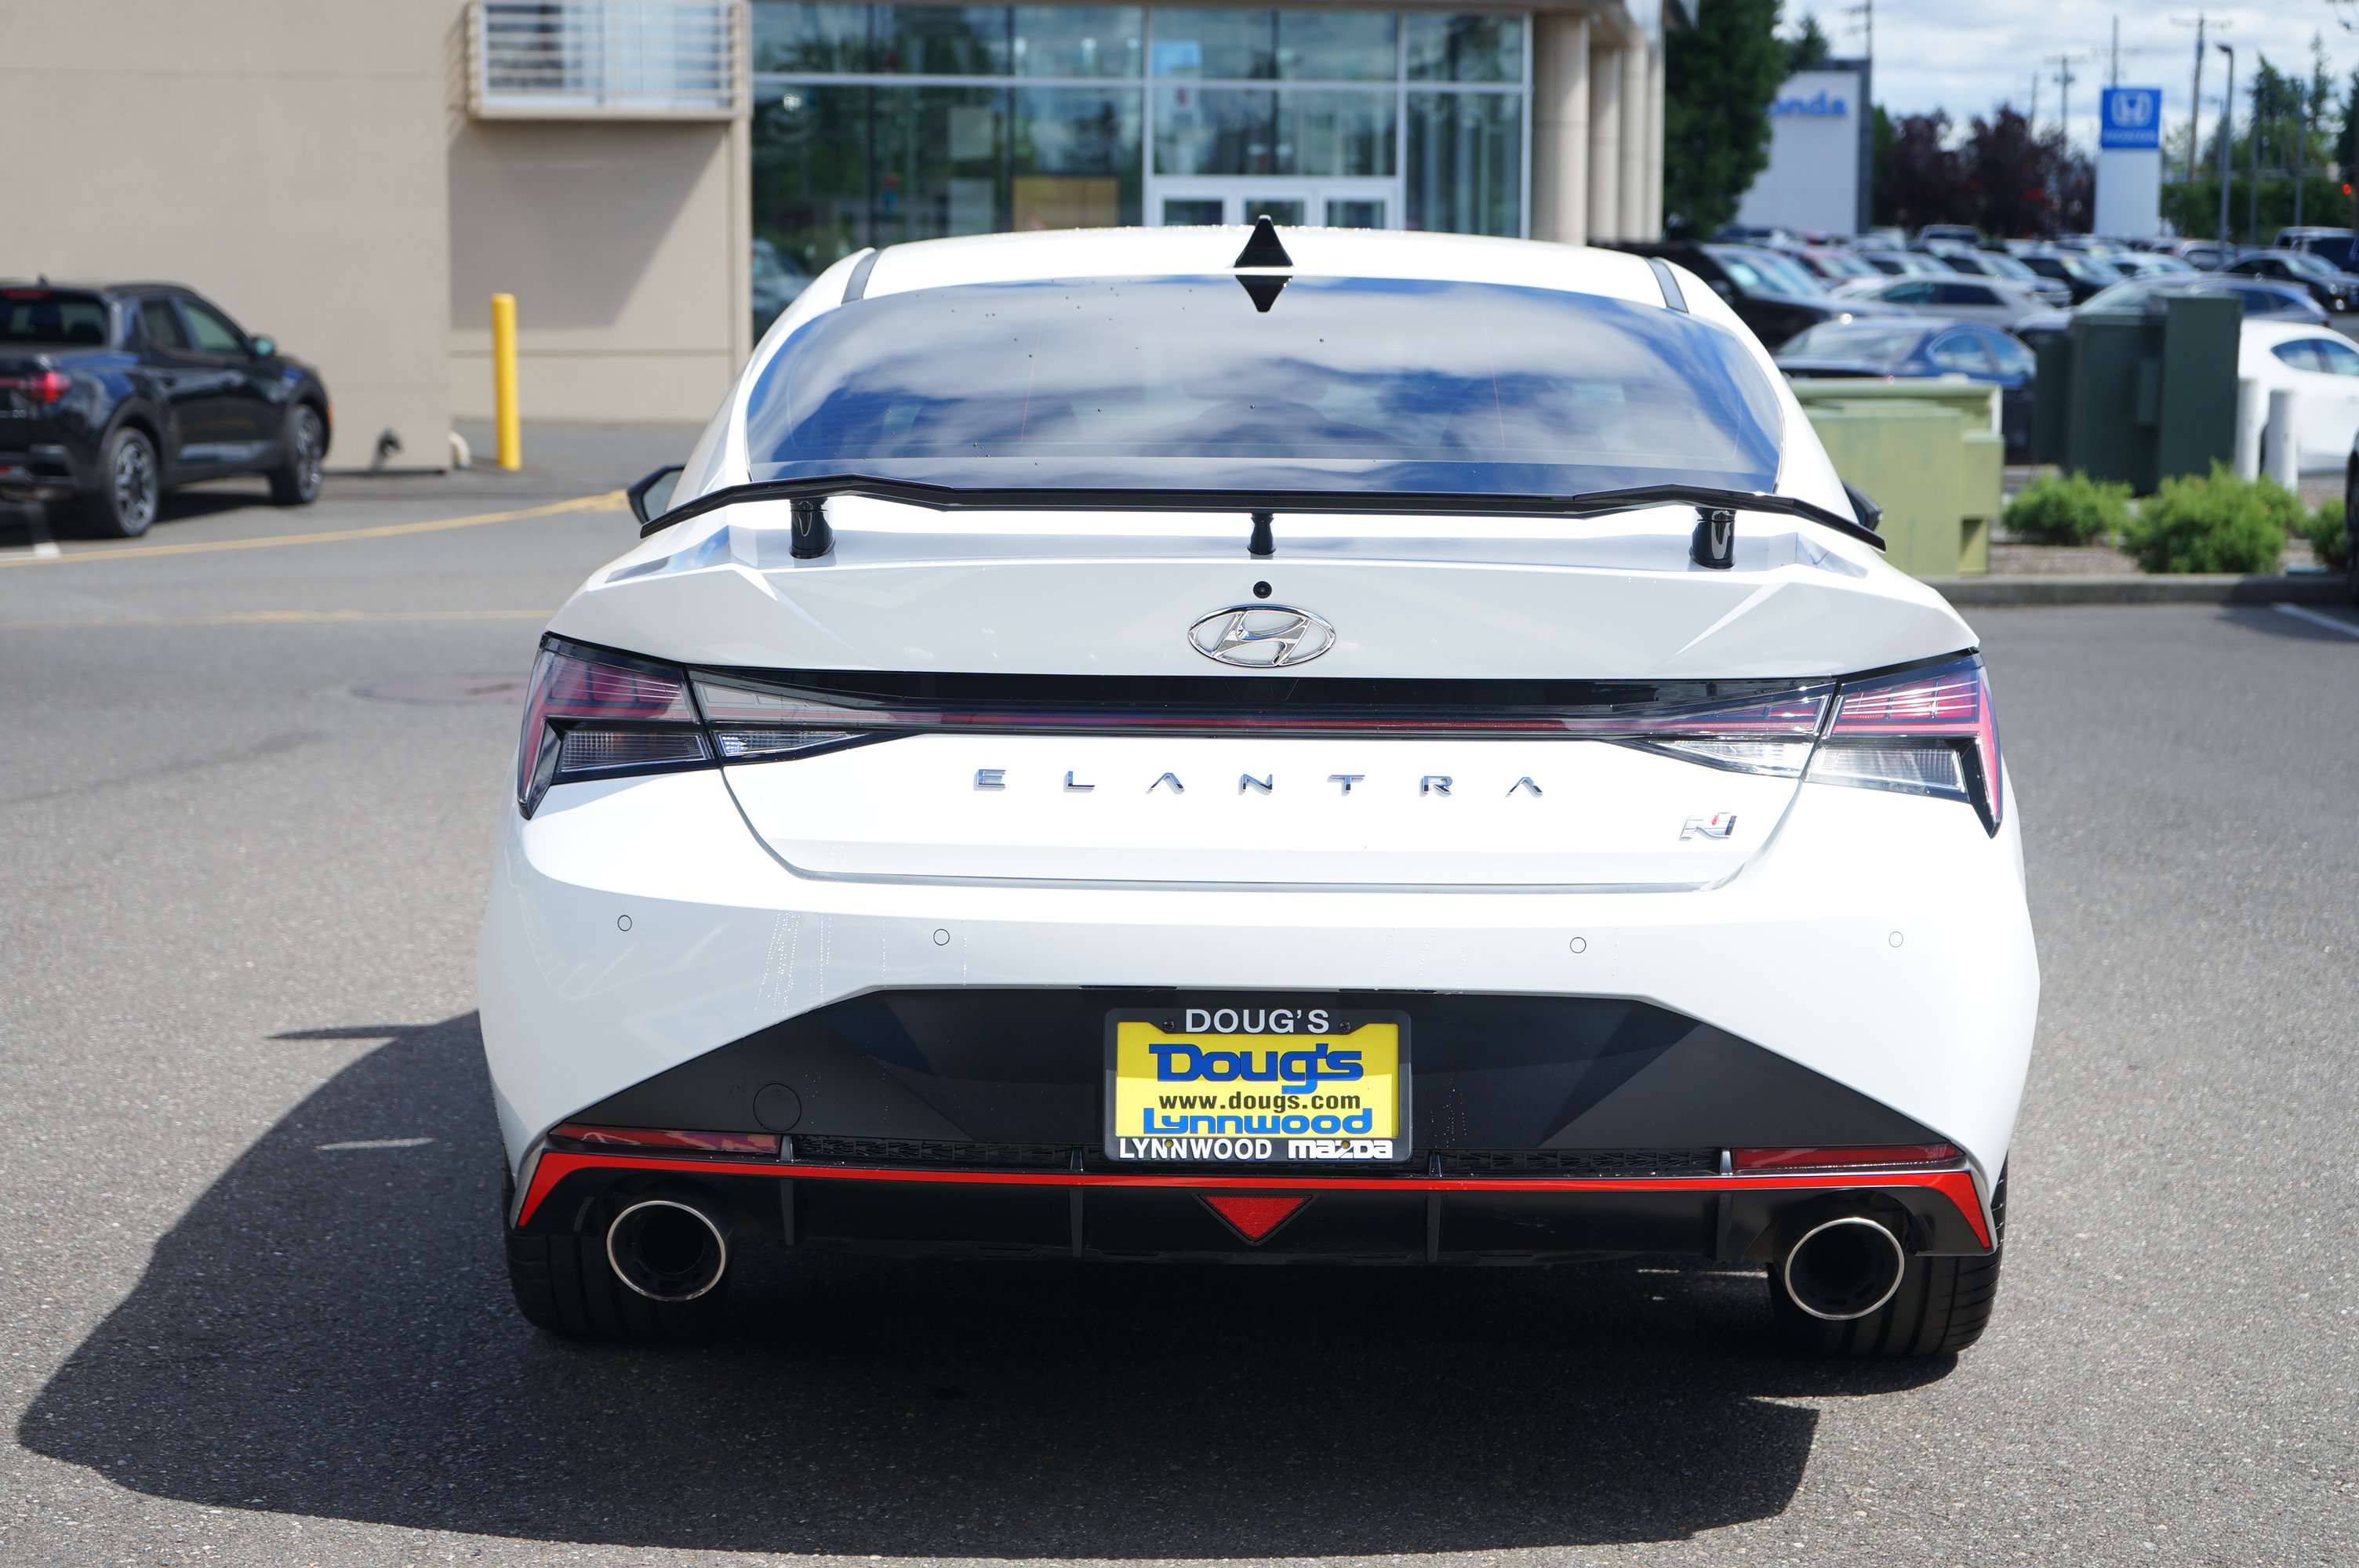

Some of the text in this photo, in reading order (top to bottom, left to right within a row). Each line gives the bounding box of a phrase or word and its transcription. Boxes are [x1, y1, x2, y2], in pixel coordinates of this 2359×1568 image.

[1766, 88, 1846, 117] onda
[973, 768, 1543, 798] ELANTRA
[1185, 1008, 1330, 1034] DOUG'S
[1148, 1044, 1365, 1094] Doug's
[1158, 1091, 1361, 1113] www.dougs.com
[1143, 1108, 1372, 1134] Lynnwood
[1118, 1138, 1273, 1160] LYNNWOOD
